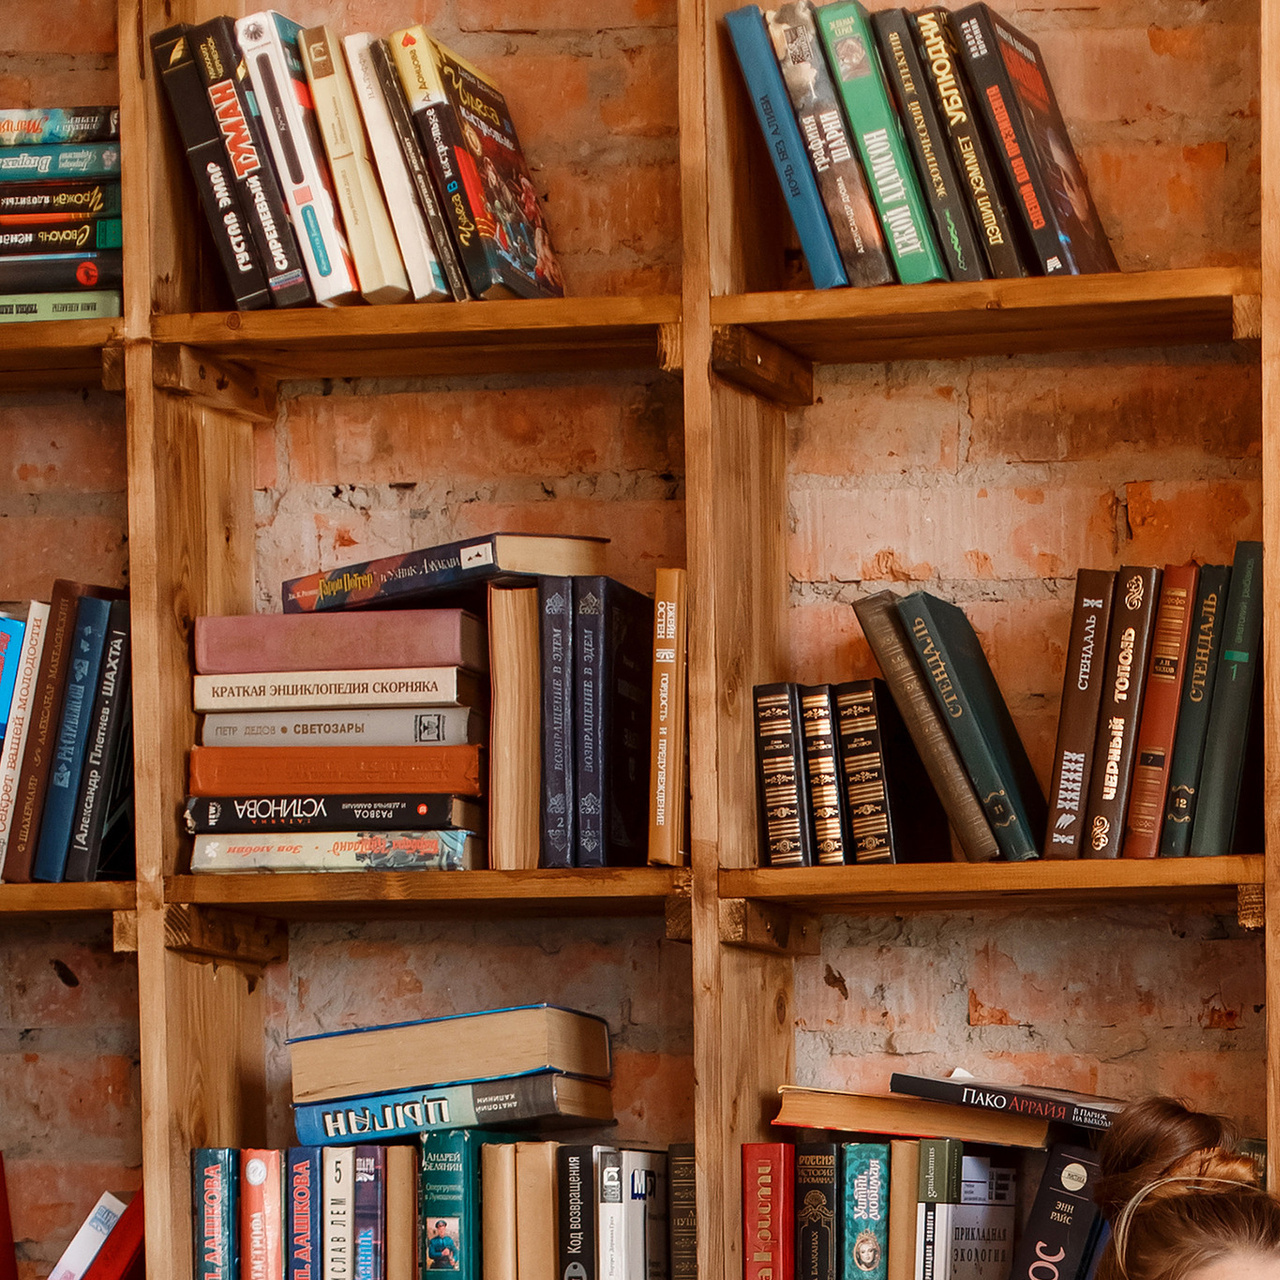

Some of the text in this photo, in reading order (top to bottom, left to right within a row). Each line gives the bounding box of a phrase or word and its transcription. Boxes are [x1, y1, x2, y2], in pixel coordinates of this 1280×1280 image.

[409, 49, 429, 90] Донцова
[802, 115, 830, 171] графиня
[820, 110, 851, 163] ШАРНИ
[889, 32, 948, 199] ЭКЗОТИЧЕСКИЙ ДЕТЕКТИВ
[759, 94, 801, 197] НОЧЬ БЕЗ АЛИБИ
[53, 186, 103, 211] Урожай
[208, 79, 288, 271] СИРЕНЕВЫЙ ТУМАН
[863, 129, 924, 257] ДЖОЙ АДАМСОН
[958, 135, 1003, 245] ДЭШИЛ ХЭММЕТ
[38, 225, 90, 246] Сволочь
[206, 162, 253, 272] ГУСТАВ ЭМАР
[836, 176, 865, 253] АЛЕКСАНДР ДЮМА
[584, 629, 594, 663] ЭДЕМ
[911, 617, 963, 718] СТЕНДАЛЬ
[1078, 615, 1097, 690] СТЕНДАЛЬ
[1189, 593, 1218, 702] СТЕНДАЛЬ
[212, 681, 438, 698] КРАТКАЯ ЭНЦИКЛОПЕДИЯ СКОРНЯКА
[553, 628, 564, 771] ВОЗВРАЩЕНИЕ В ЭДЕМ
[1102, 627, 1135, 800] ЧЕРНЫЙ ТОПОЛЬ
[76, 638, 123, 844] Александр Плетнев ШАХТА
[215, 723, 365, 736] ПЕТР ДЕДОВ СВЕТОЗАРЫ
[584, 680, 594, 773] ВОЗВРАЩЕНИЕ
[234, 799, 327, 819] УСТИНОВА
[354, 810, 393, 819] РАЗВОД
[322, 1095, 450, 1138] ЦЫГАН
[475, 1101, 518, 1112] АНАТОЛИЙ
[477, 1093, 516, 1103] КАЛИНИН
[962, 1088, 1066, 1120] ПАКО АРРАЙЯ
[923, 1147, 937, 1198] gaudeamus
[293, 1160, 312, 1262] ДАШКОВА
[330, 1197, 346, 1227] ЛЕМ
[567, 1156, 583, 1254] Код возвращения
[753, 1160, 776, 1262] Кристи
[925, 1211, 934, 1243] ЭКОЛОГИЯ
[810, 1231, 819, 1275] БАЛКАНАХ
